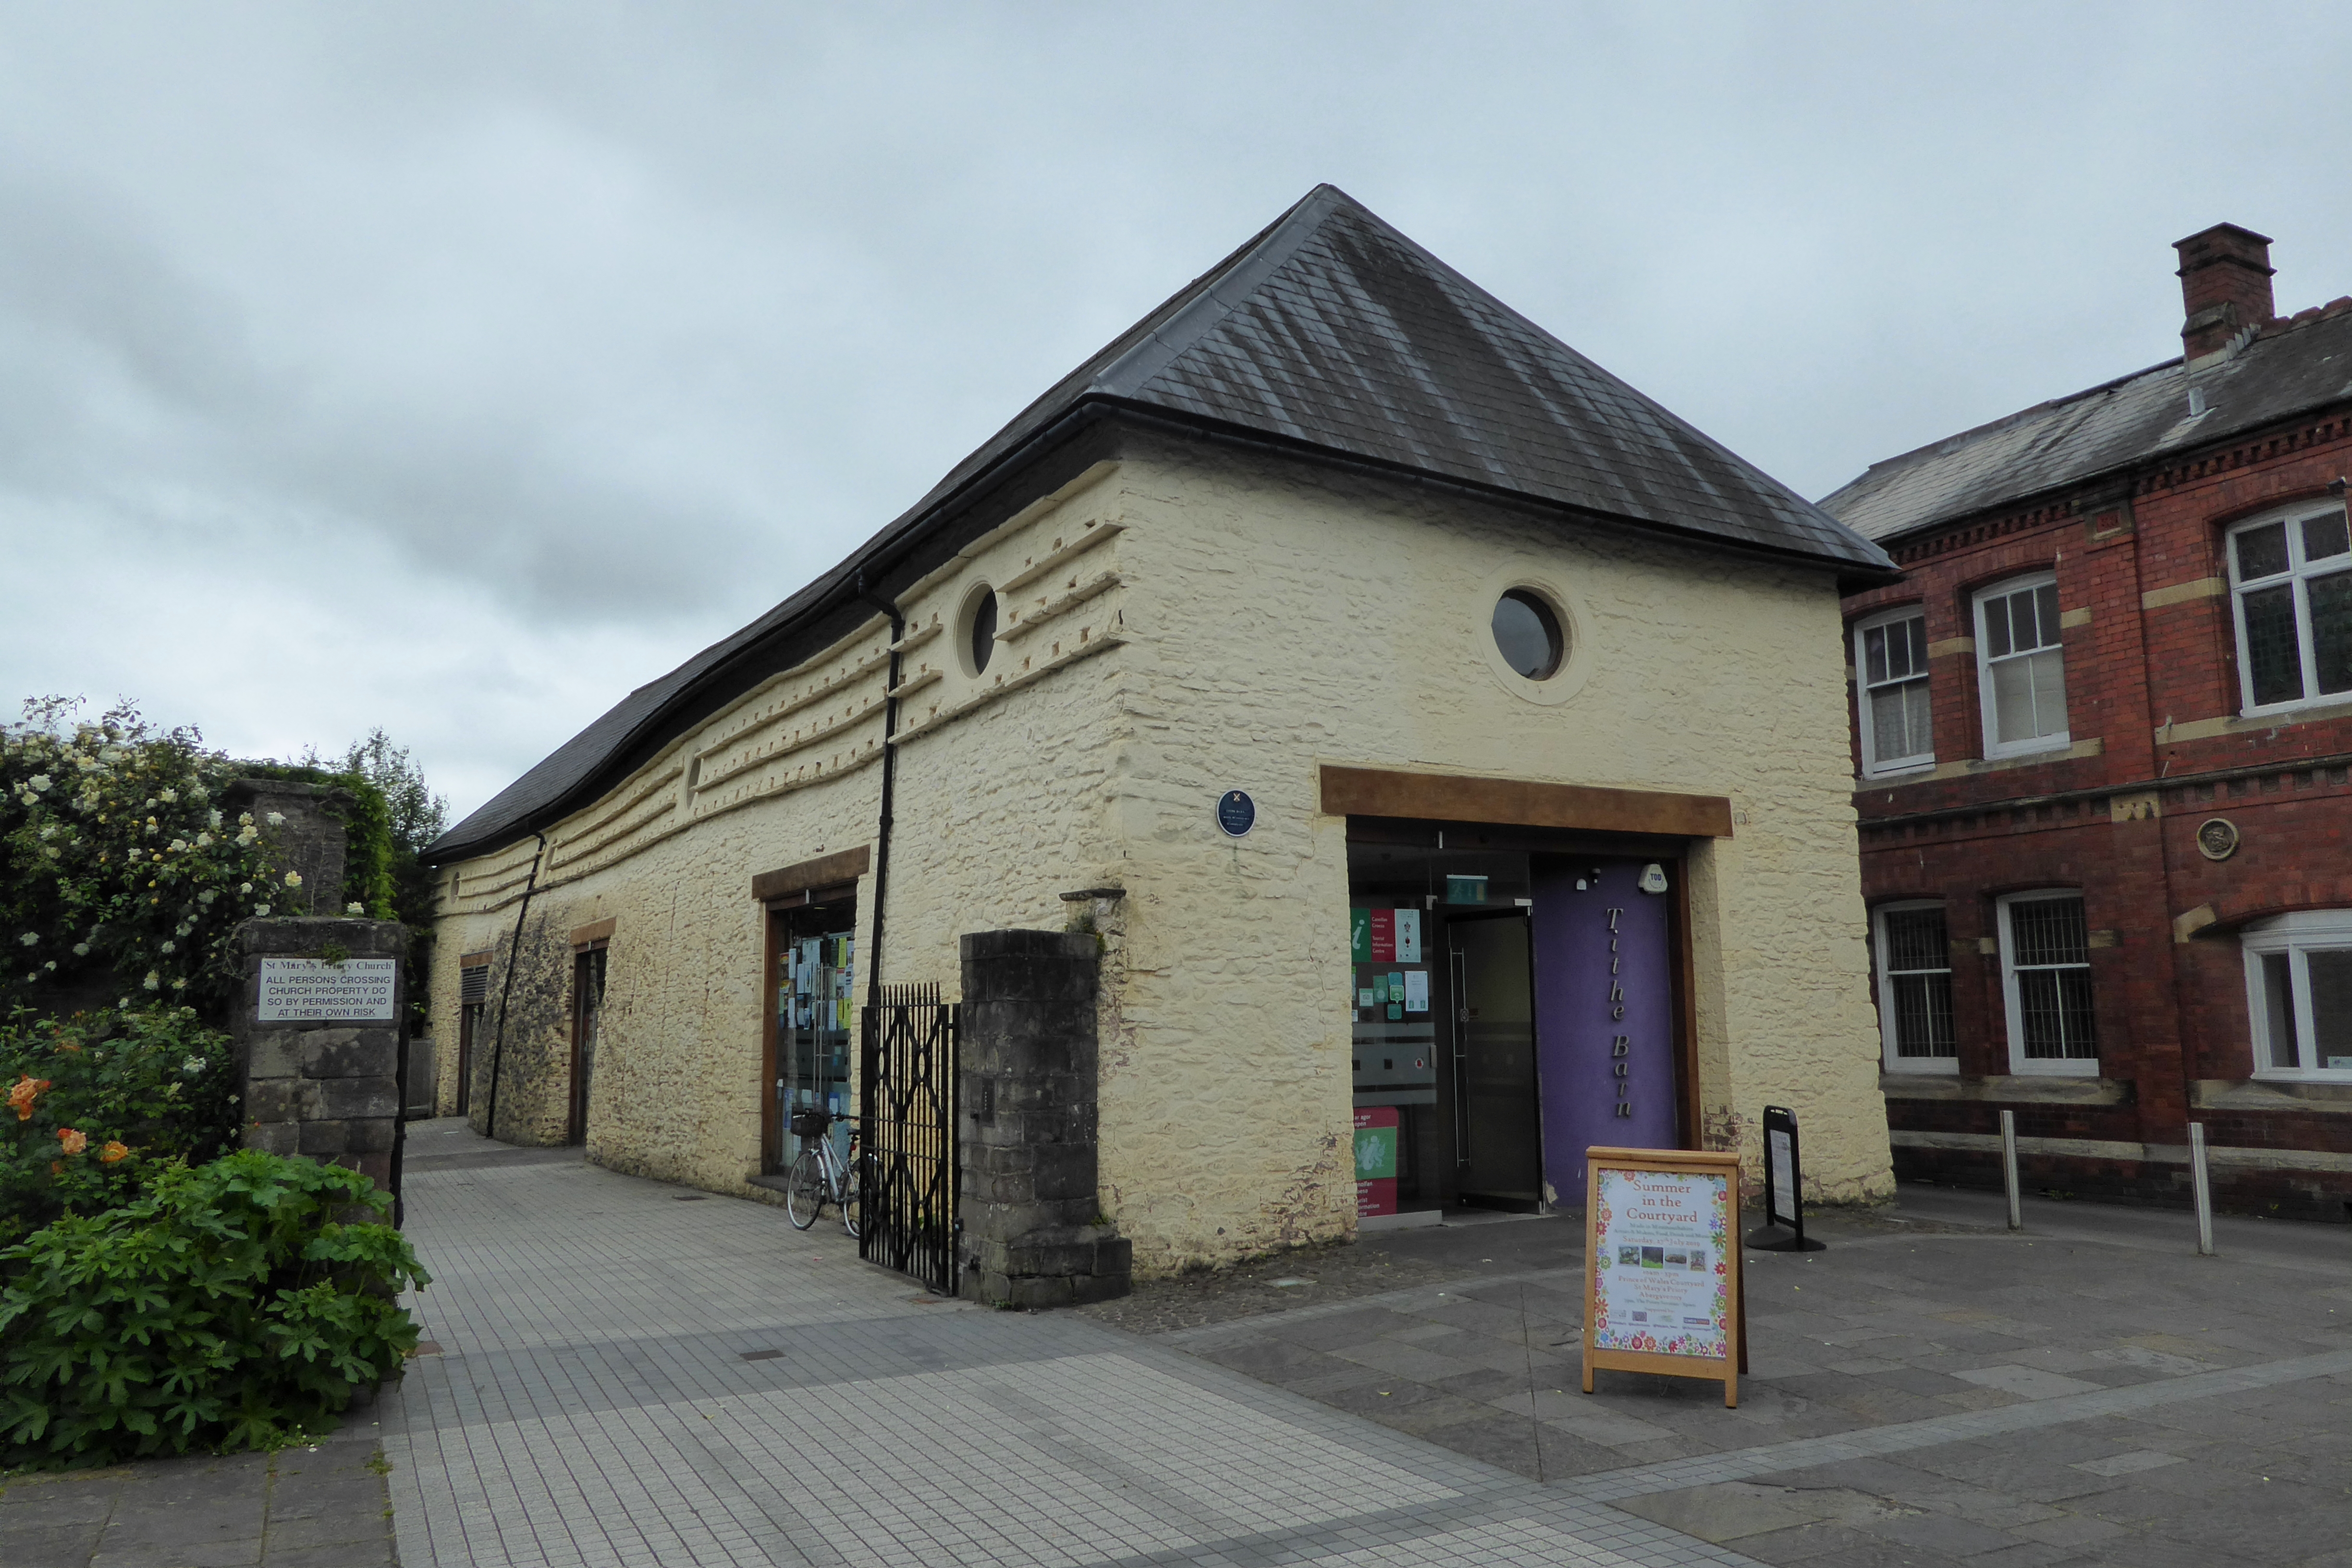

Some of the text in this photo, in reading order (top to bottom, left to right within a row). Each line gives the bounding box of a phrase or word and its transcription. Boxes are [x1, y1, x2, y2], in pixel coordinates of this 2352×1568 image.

[1606, 908, 1631, 1116] Tithe Barn
[1633, 1180, 1691, 1193] Summer
[1642, 1195, 1681, 1207] in the
[1626, 1208, 1697, 1225] Courtyard
[1670, 1279, 1704, 1287] Courtyard
[1640, 1291, 1682, 1301] Abergavenny
[1667, 1286, 1688, 1294] Priory
